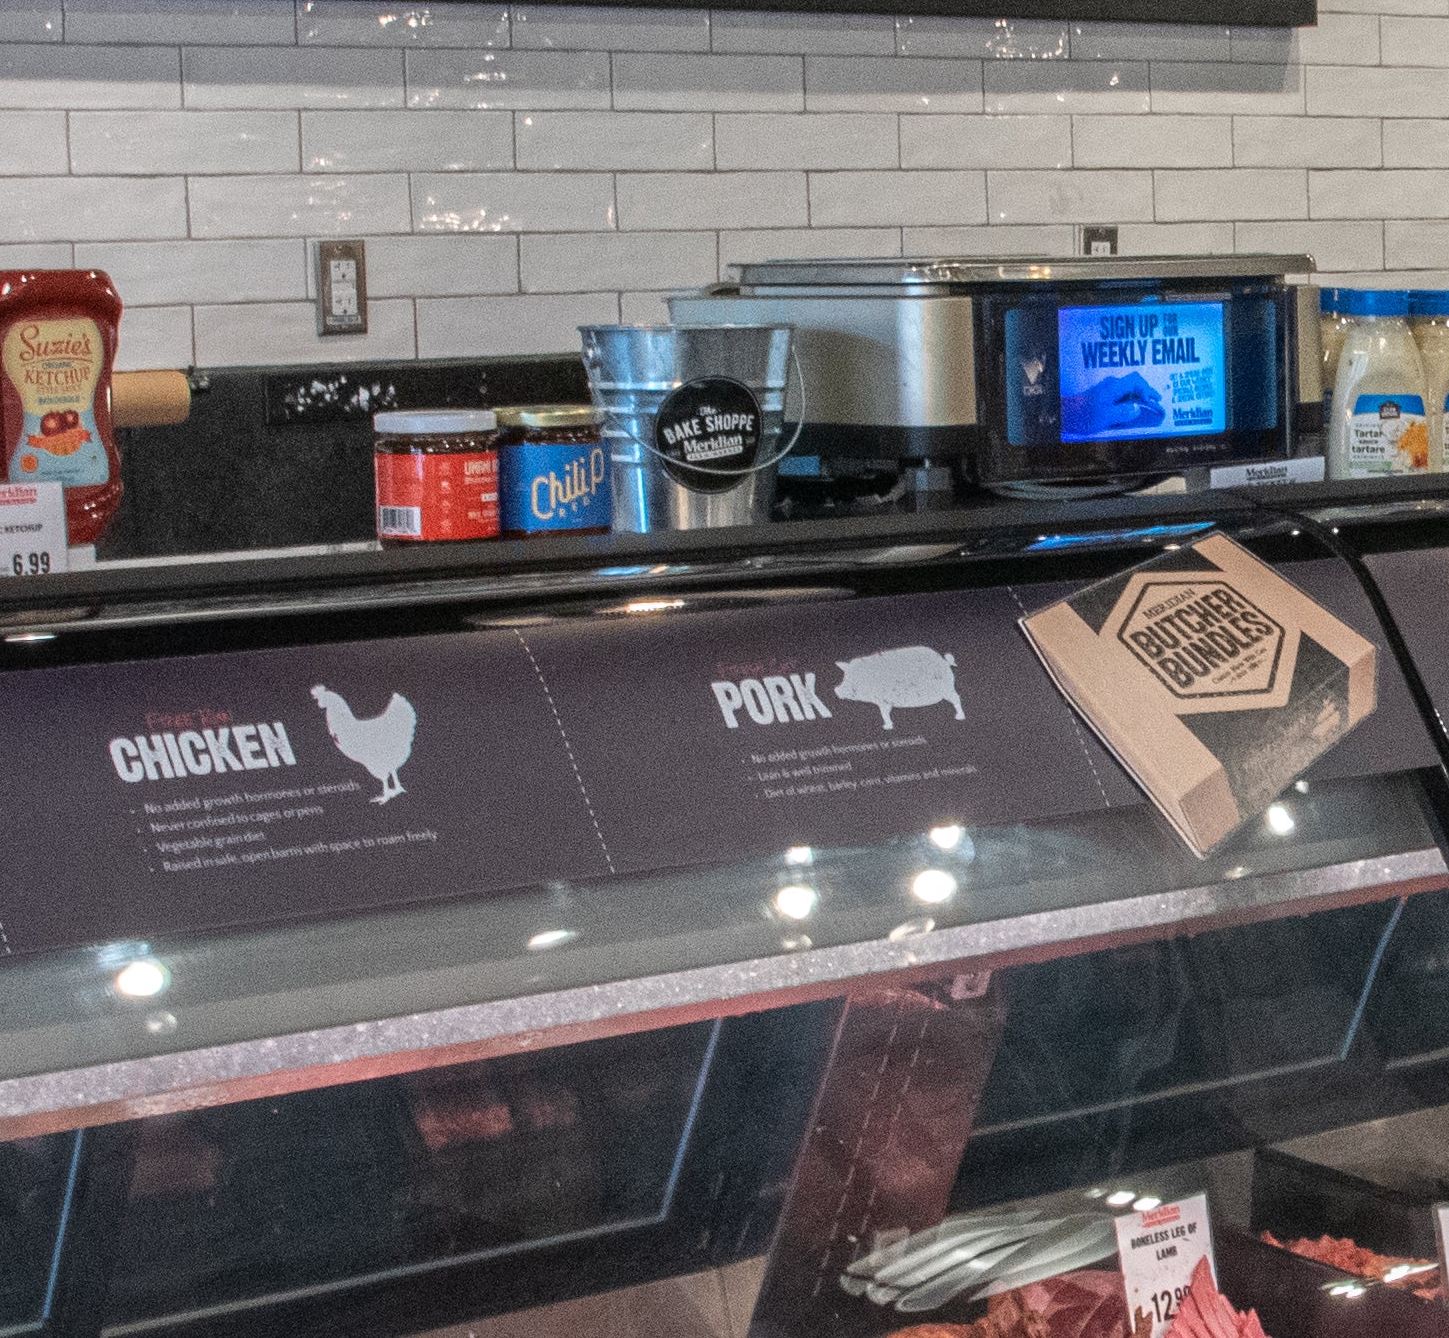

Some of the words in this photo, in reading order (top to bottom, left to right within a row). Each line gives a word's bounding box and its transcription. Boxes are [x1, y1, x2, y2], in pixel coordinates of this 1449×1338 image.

[1100, 314, 1136, 341] SIGN
[1139, 313, 1159, 339] UP
[1081, 338, 1149, 369] WEEKLY
[1152, 336, 1201, 367] EMAIL
[663, 419, 704, 444] BAKE
[704, 412, 755, 435] SHOPPE
[682, 434, 744, 455] Meridian
[12, 552, 51, 575] 6.99
[1142, 587, 1196, 621] MERIDIAN
[1129, 588, 1245, 661] BUTCHER
[1155, 610, 1275, 690] BUNDLES
[711, 672, 833, 729] PORK
[109, 721, 297, 783] CHICKEN
